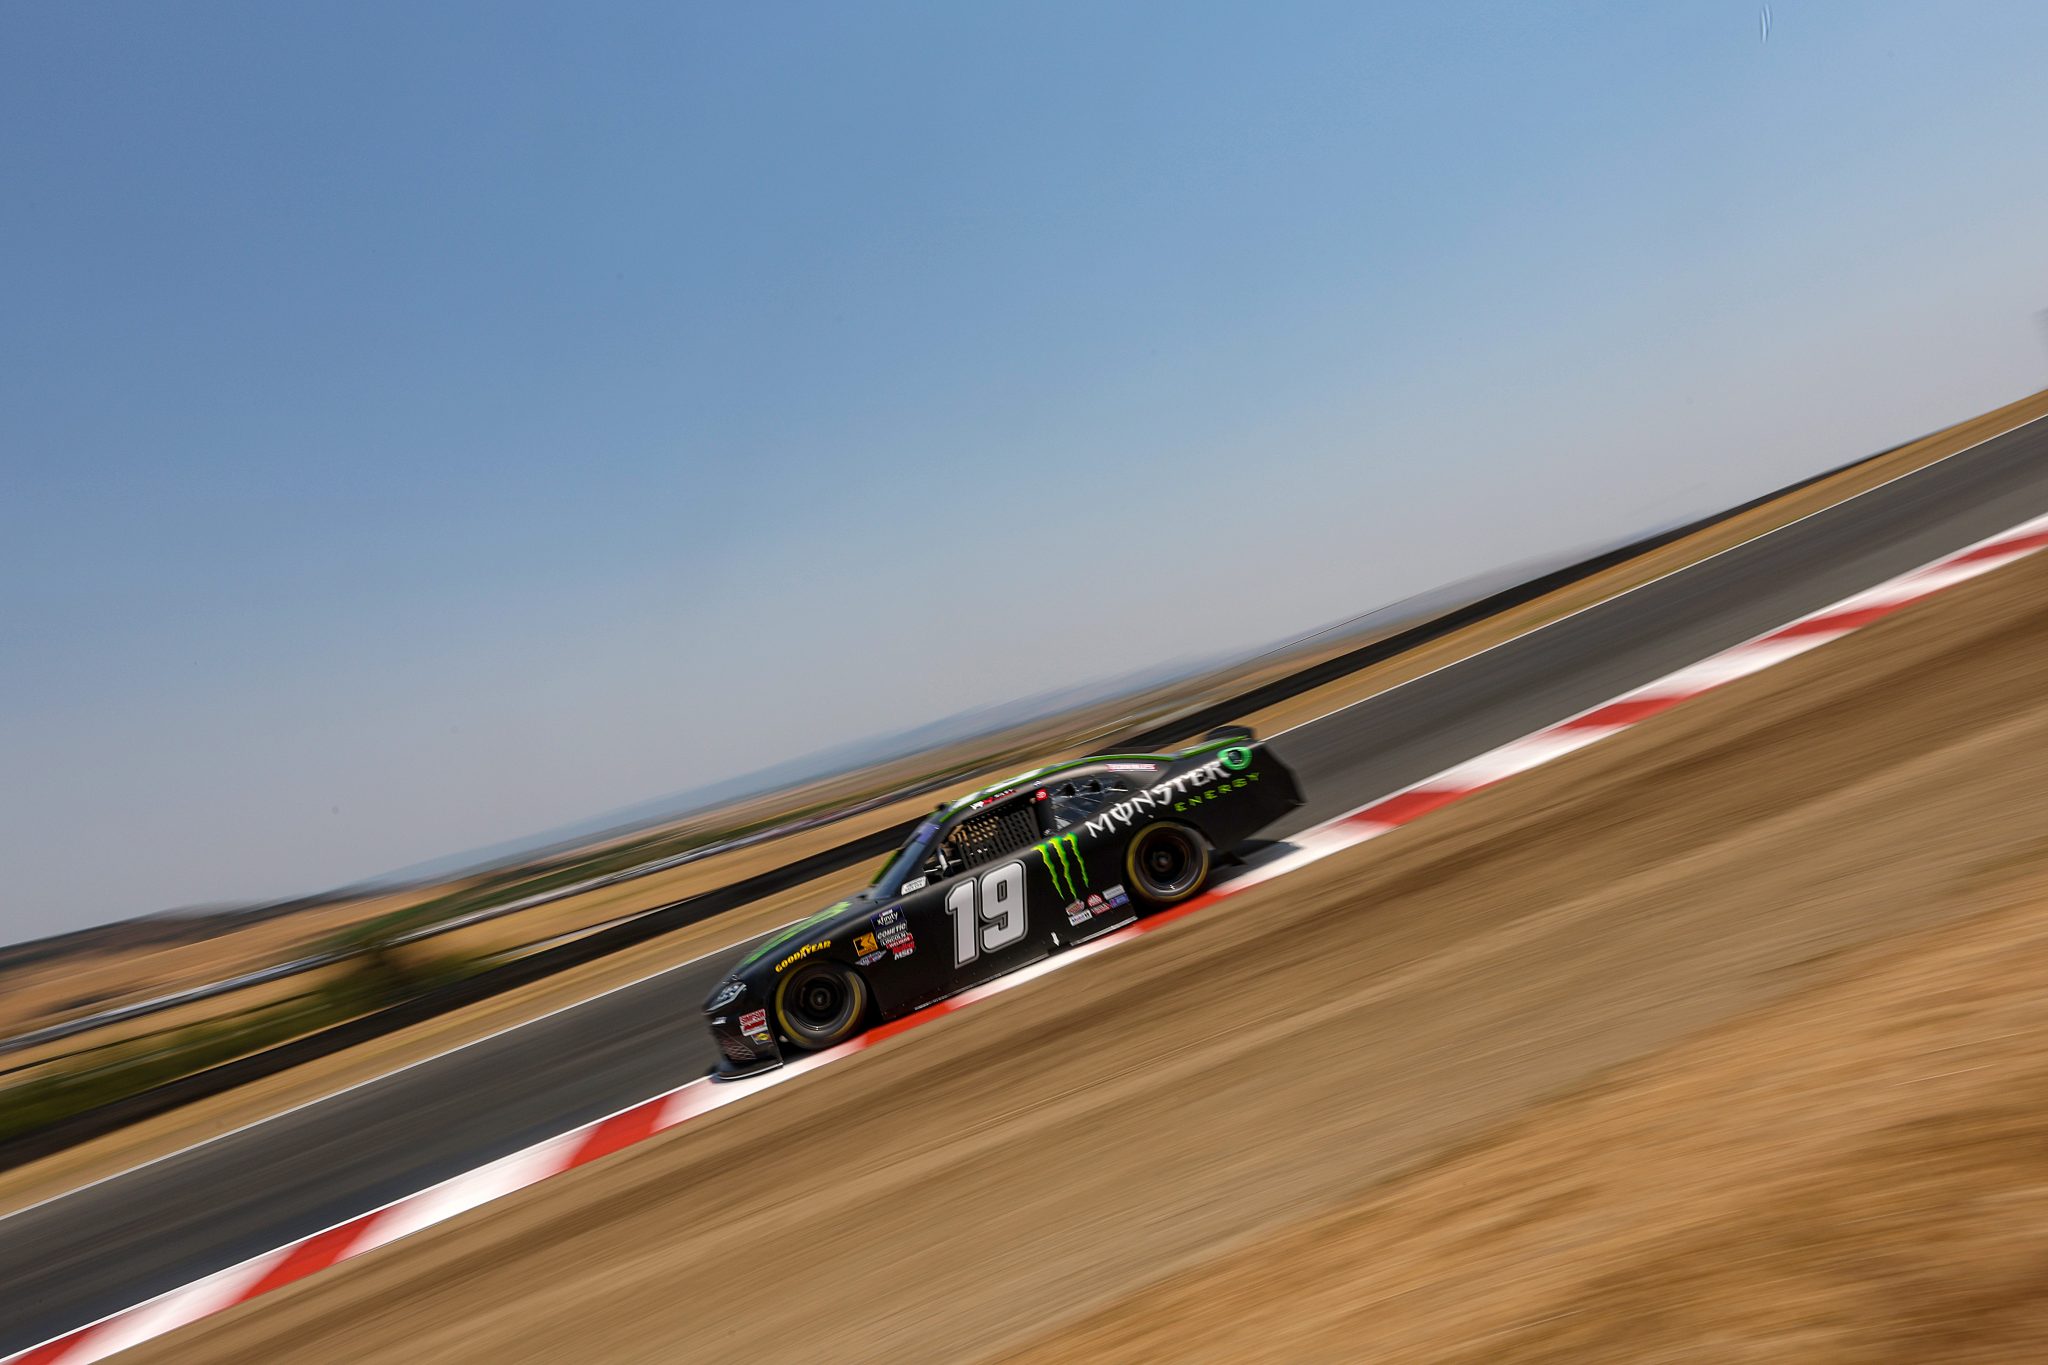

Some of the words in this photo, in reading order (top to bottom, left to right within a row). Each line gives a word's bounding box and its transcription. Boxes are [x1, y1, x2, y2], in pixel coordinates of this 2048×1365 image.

[1085, 760, 1232, 838] MONSTER
[1174, 772, 1260, 812] ENERGY
[945, 859, 1028, 969] 19
[775, 940, 831, 973] GOODYEAR
[894, 948, 914, 961] MSD
